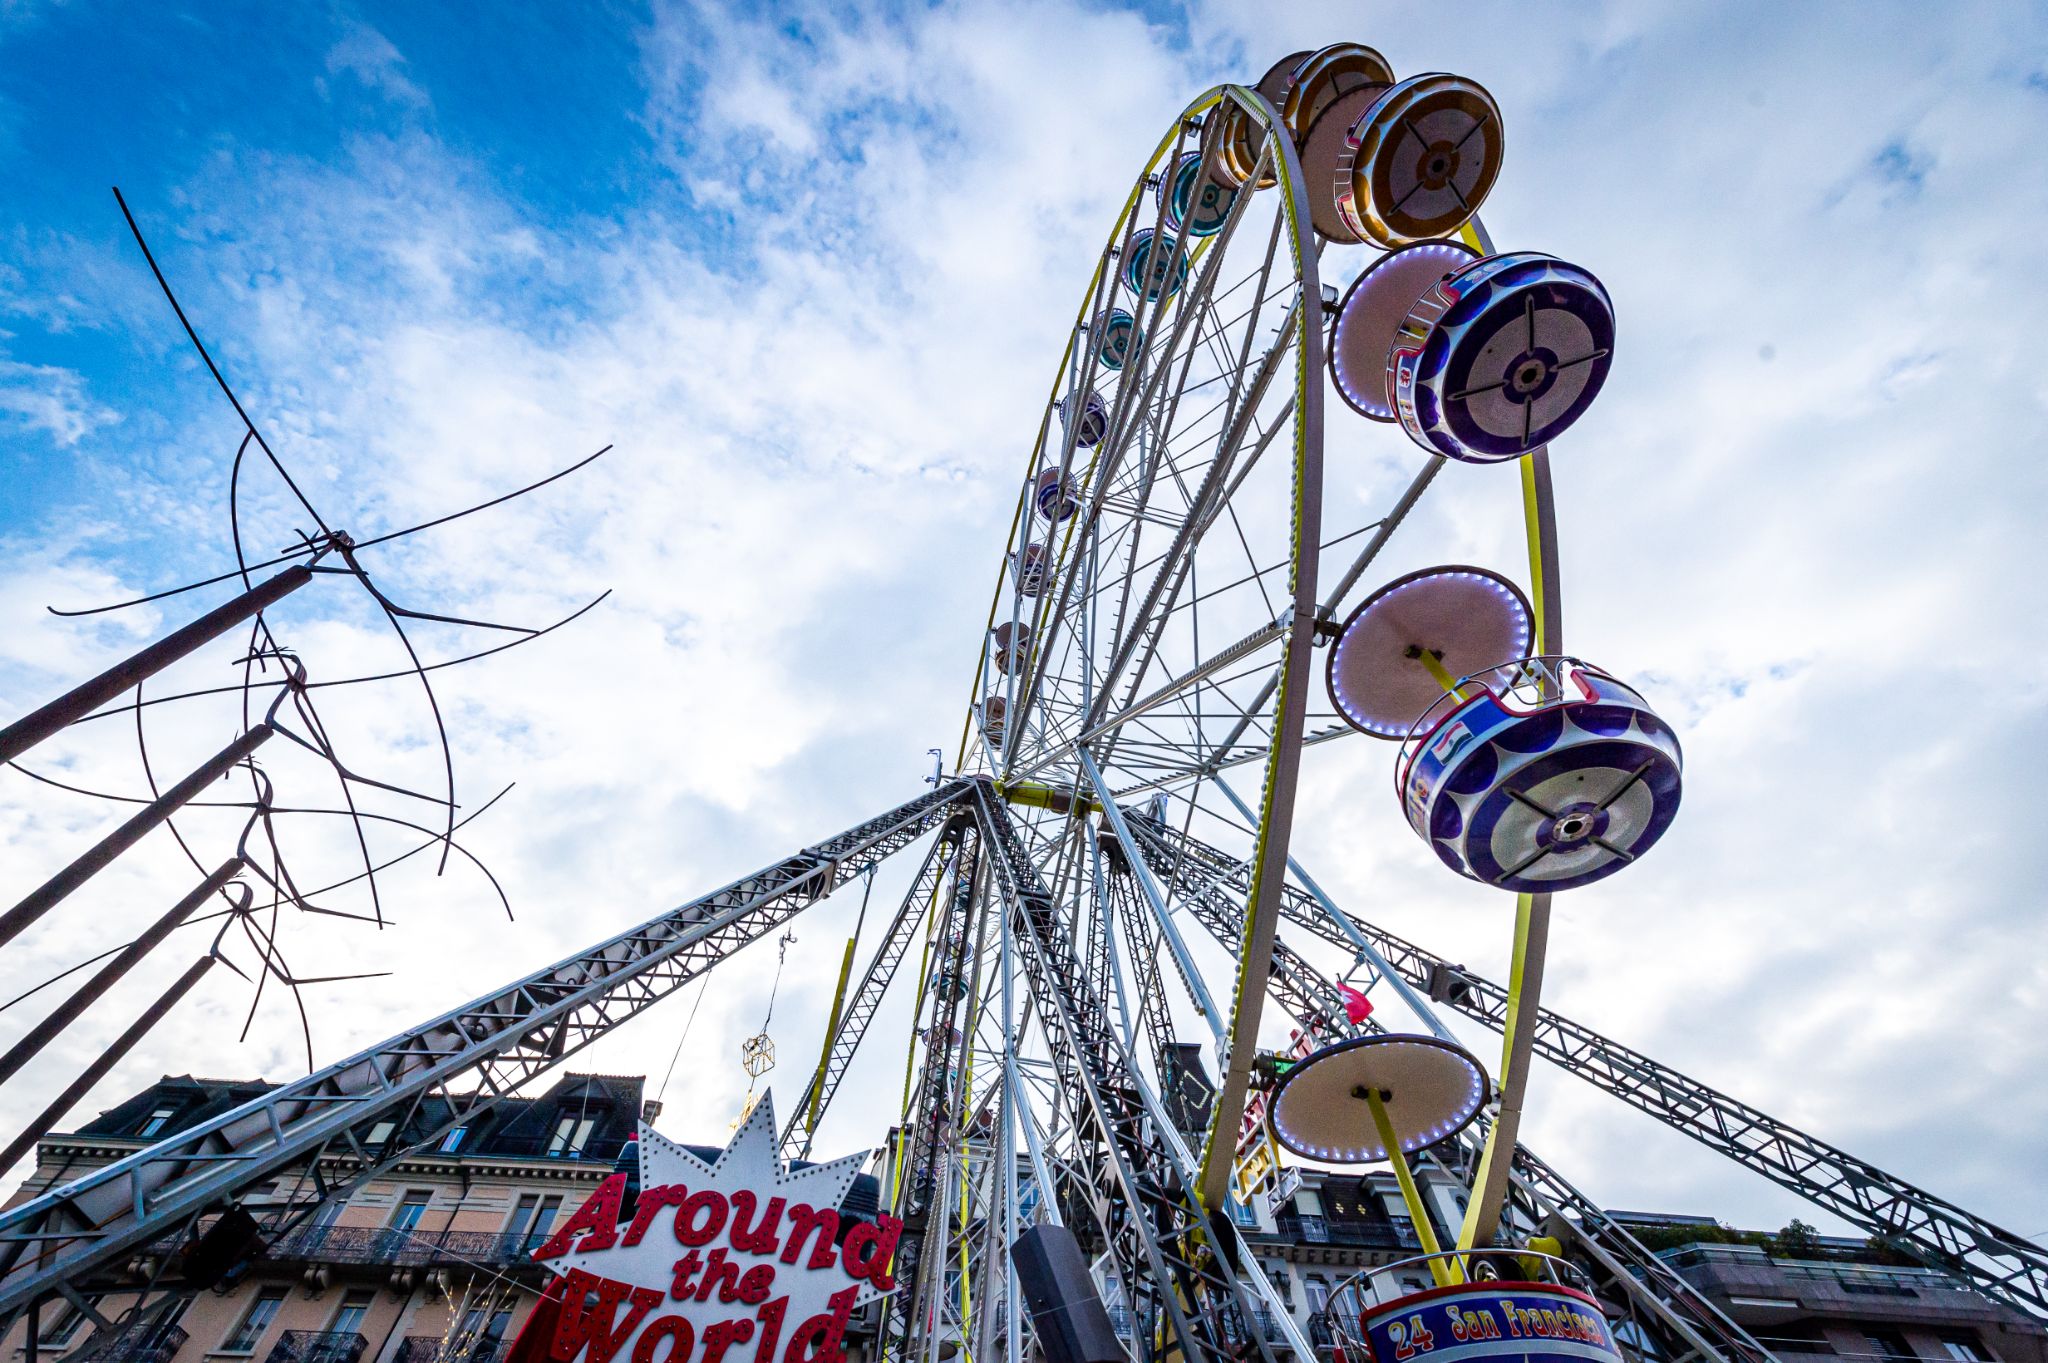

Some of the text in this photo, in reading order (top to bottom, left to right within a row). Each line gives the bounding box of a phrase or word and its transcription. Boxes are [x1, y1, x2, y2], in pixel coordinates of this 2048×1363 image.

[531, 1172, 904, 1291] Around
[550, 1266, 861, 1363] World
[670, 1246, 777, 1304] the
[1387, 1300, 1606, 1361] 24 San Francisco
